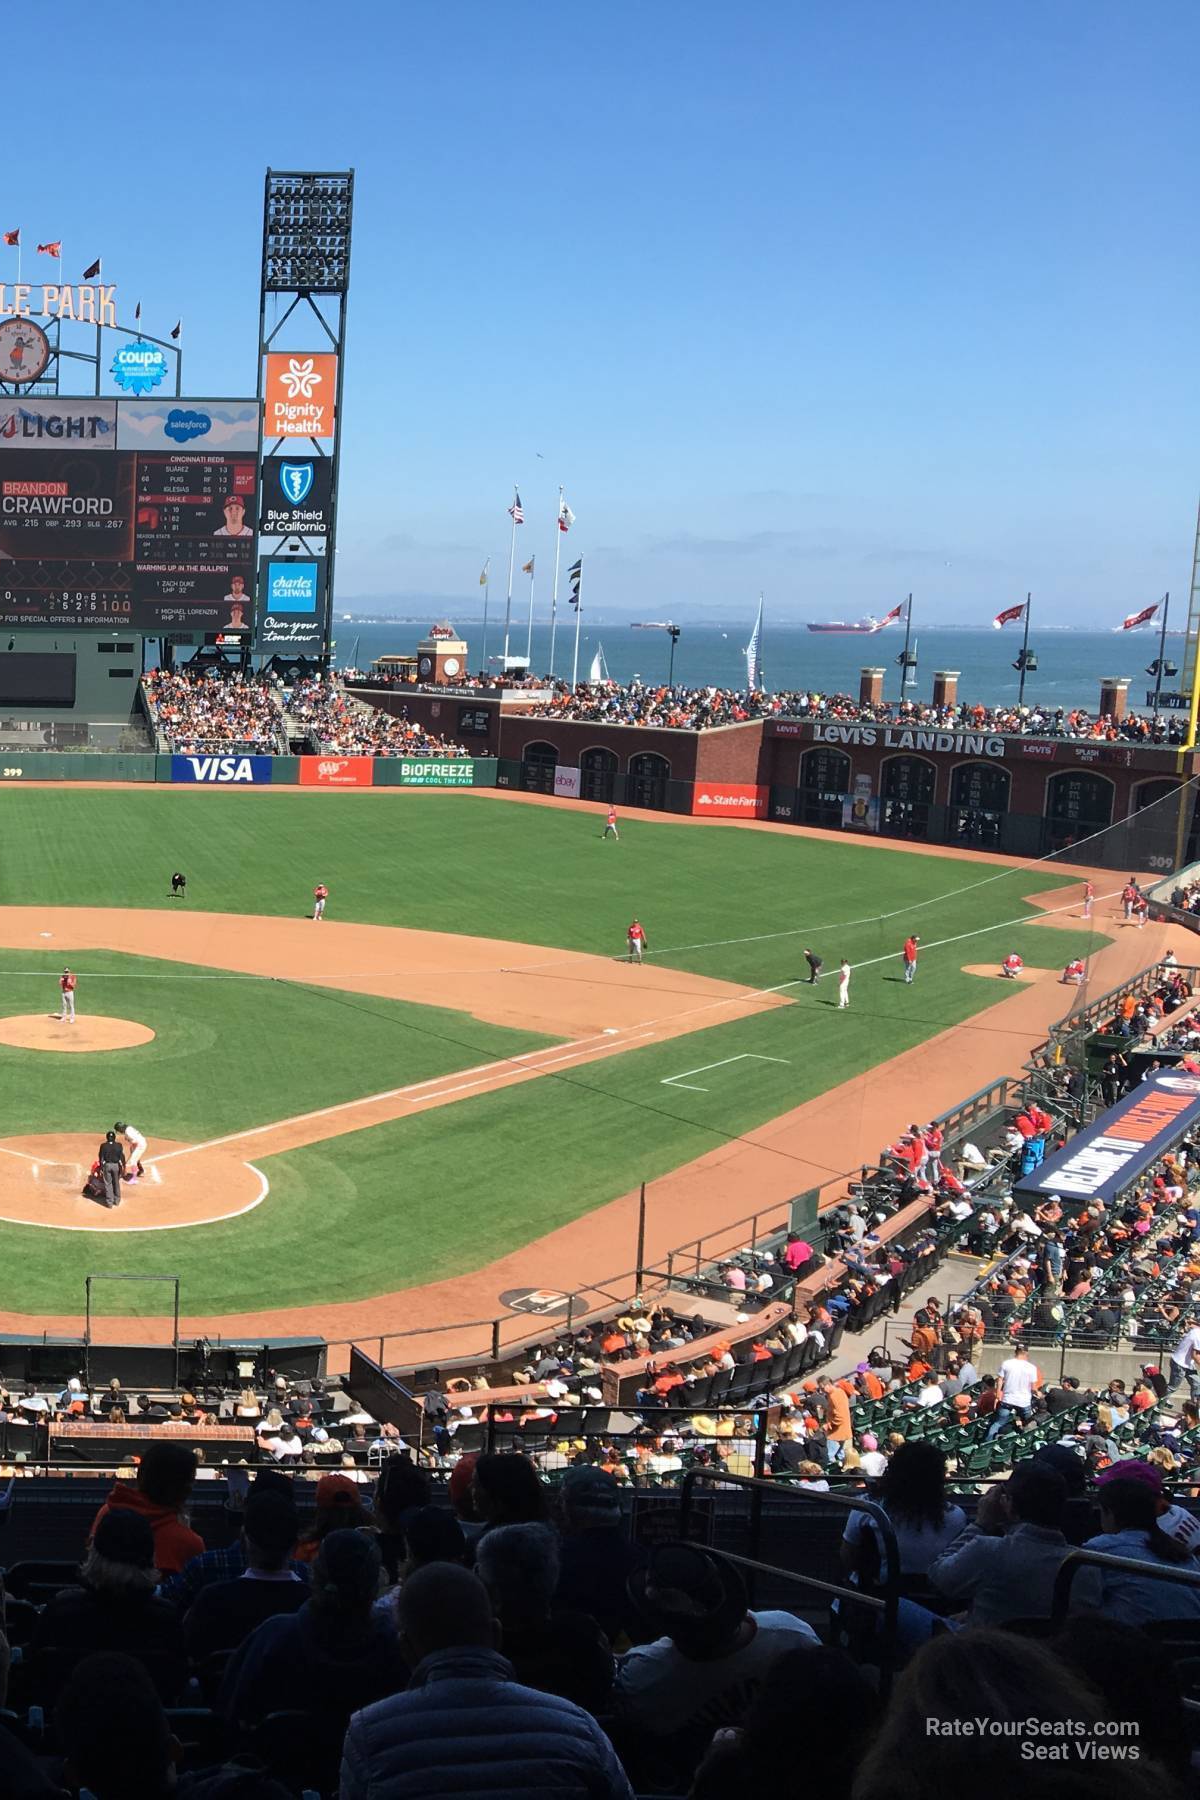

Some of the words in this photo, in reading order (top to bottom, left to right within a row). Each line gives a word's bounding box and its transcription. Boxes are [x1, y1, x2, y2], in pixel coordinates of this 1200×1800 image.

[42, 284, 118, 328] PARK
[118, 351, 162, 368] coupa
[274, 402, 324, 420] Dignity
[22, 416, 102, 438] LIGHT
[170, 420, 208, 430] salesforce
[4, 483, 66, 495] BRANDON
[2, 496, 113, 514] CRAWFORD
[268, 510, 289, 520] Blue
[292, 510, 322, 520] Shield
[22, 519, 39, 527] .215
[63, 520, 82, 528] .293
[104, 520, 124, 528] .267
[264, 522, 274, 532] of
[276, 522, 326, 532] California
[272, 576, 312, 588] charles
[272, 589, 312, 598] SCHWAB
[264, 616, 289, 629] Own
[288, 621, 318, 634] your
[262, 630, 320, 642] tomorrow
[884, 730, 1005, 757] LANDING
[4, 768, 22, 777] 399
[186, 758, 254, 781] VISA
[556, 775, 576, 789] ebay
[776, 806, 791, 816] 365
[1149, 856, 1173, 868] 309
[1039, 1146, 1133, 1194] WELCOME
[1088, 1136, 1146, 1153] TO
